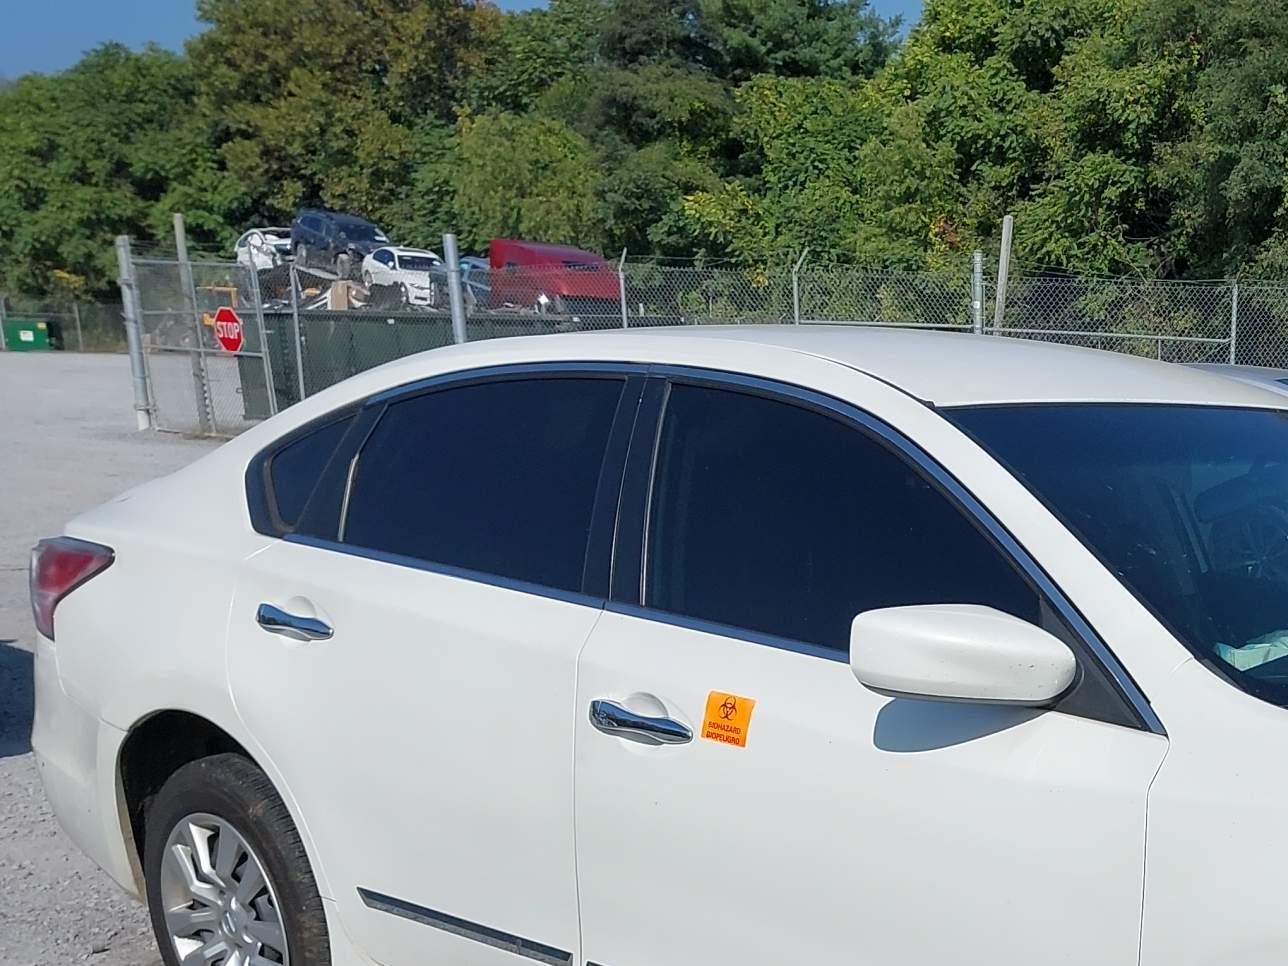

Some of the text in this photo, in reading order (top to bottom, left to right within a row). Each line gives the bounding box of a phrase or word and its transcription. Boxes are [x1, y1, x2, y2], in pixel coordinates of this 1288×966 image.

[217, 321, 239, 339] STOP
[708, 721, 741, 734] BIOHAZARD
[706, 730, 740, 745] BIOPELIGRO
